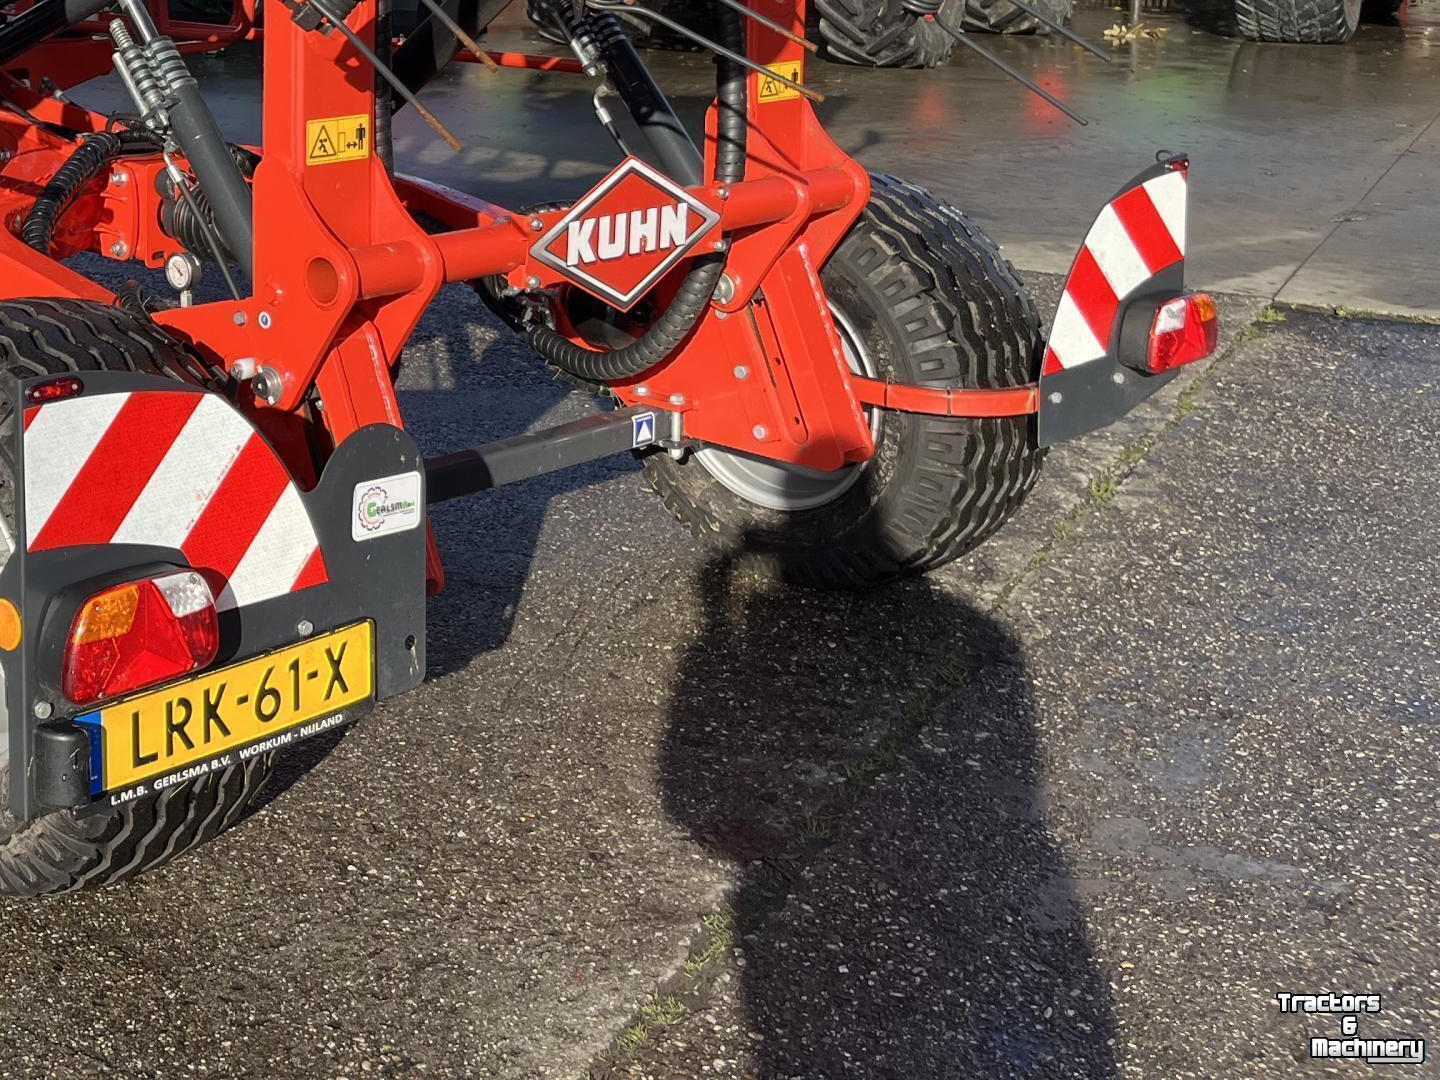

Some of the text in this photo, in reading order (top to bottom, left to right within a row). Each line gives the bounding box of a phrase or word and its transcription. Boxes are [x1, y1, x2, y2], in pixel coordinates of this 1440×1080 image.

[566, 202, 688, 267] KUHN
[131, 640, 349, 769] LRK-61-X
[110, 785, 148, 806] L.M.B.
[154, 762, 209, 790] GERLSMA
[211, 755, 231, 771] B.V.
[239, 732, 292, 760] WORKUM
